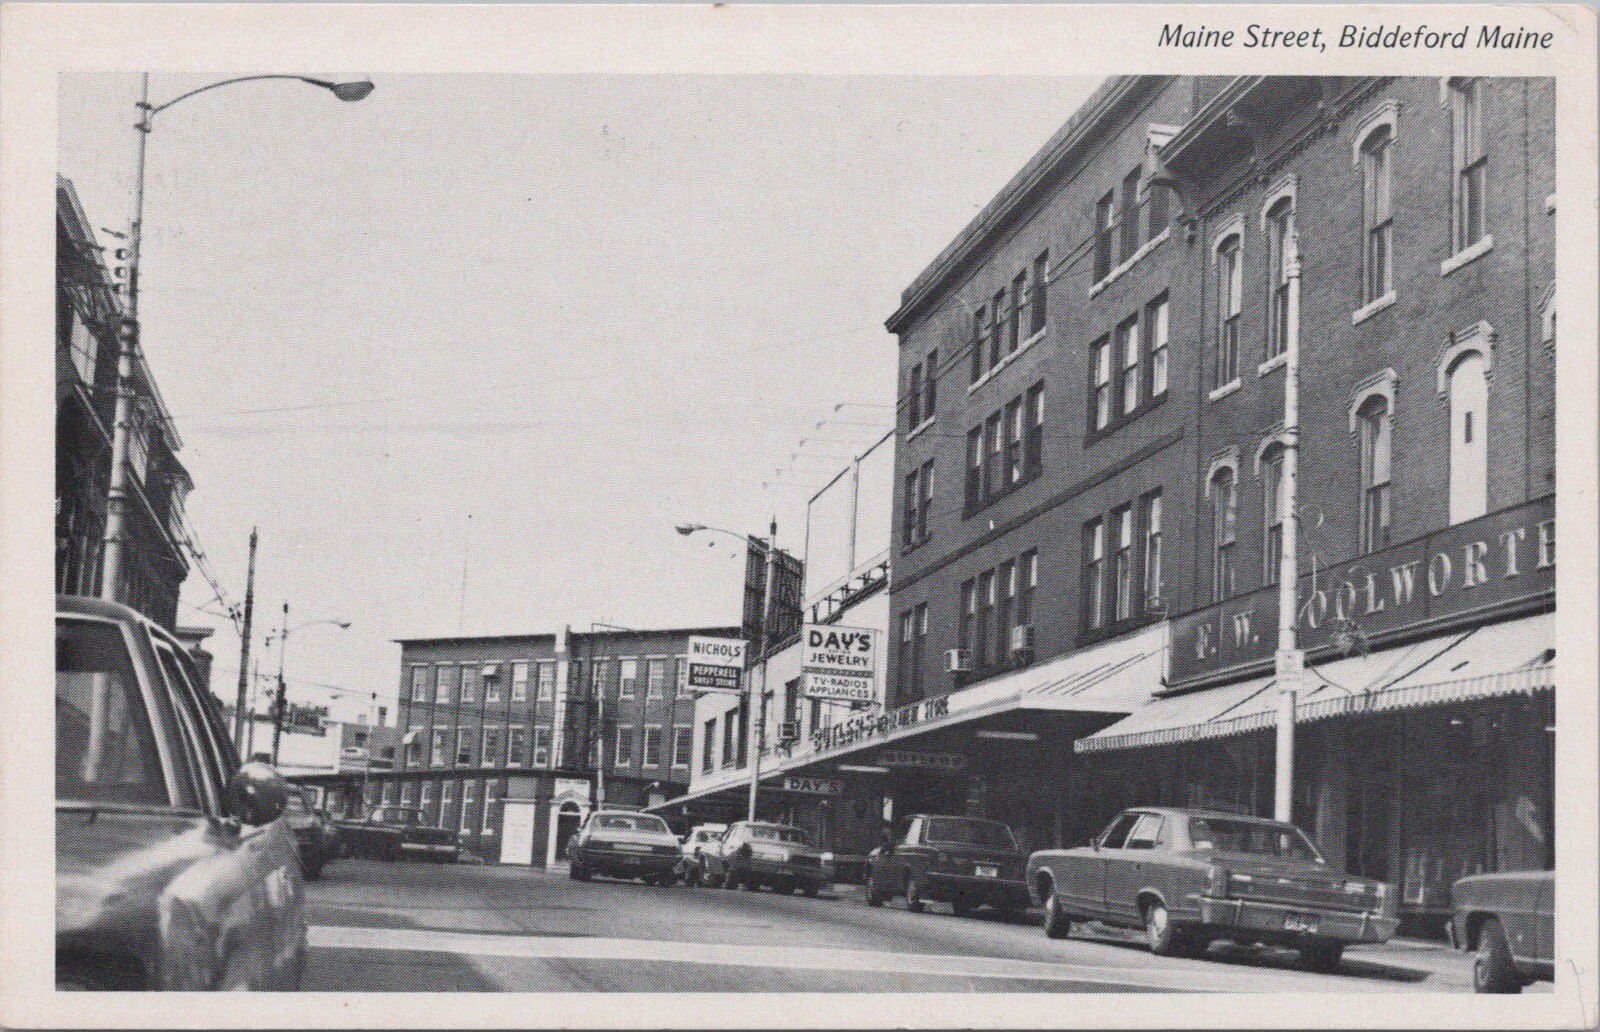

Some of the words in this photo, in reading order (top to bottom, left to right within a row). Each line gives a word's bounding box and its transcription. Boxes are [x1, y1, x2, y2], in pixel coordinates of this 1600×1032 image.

[808, 629, 871, 653] DAY'S
[693, 641, 741, 658] NICHOLS
[809, 653, 869, 667] JEWELRY
[812, 676, 869, 690] TV-RADIOS
[809, 685, 870, 699] APPLIANCES
